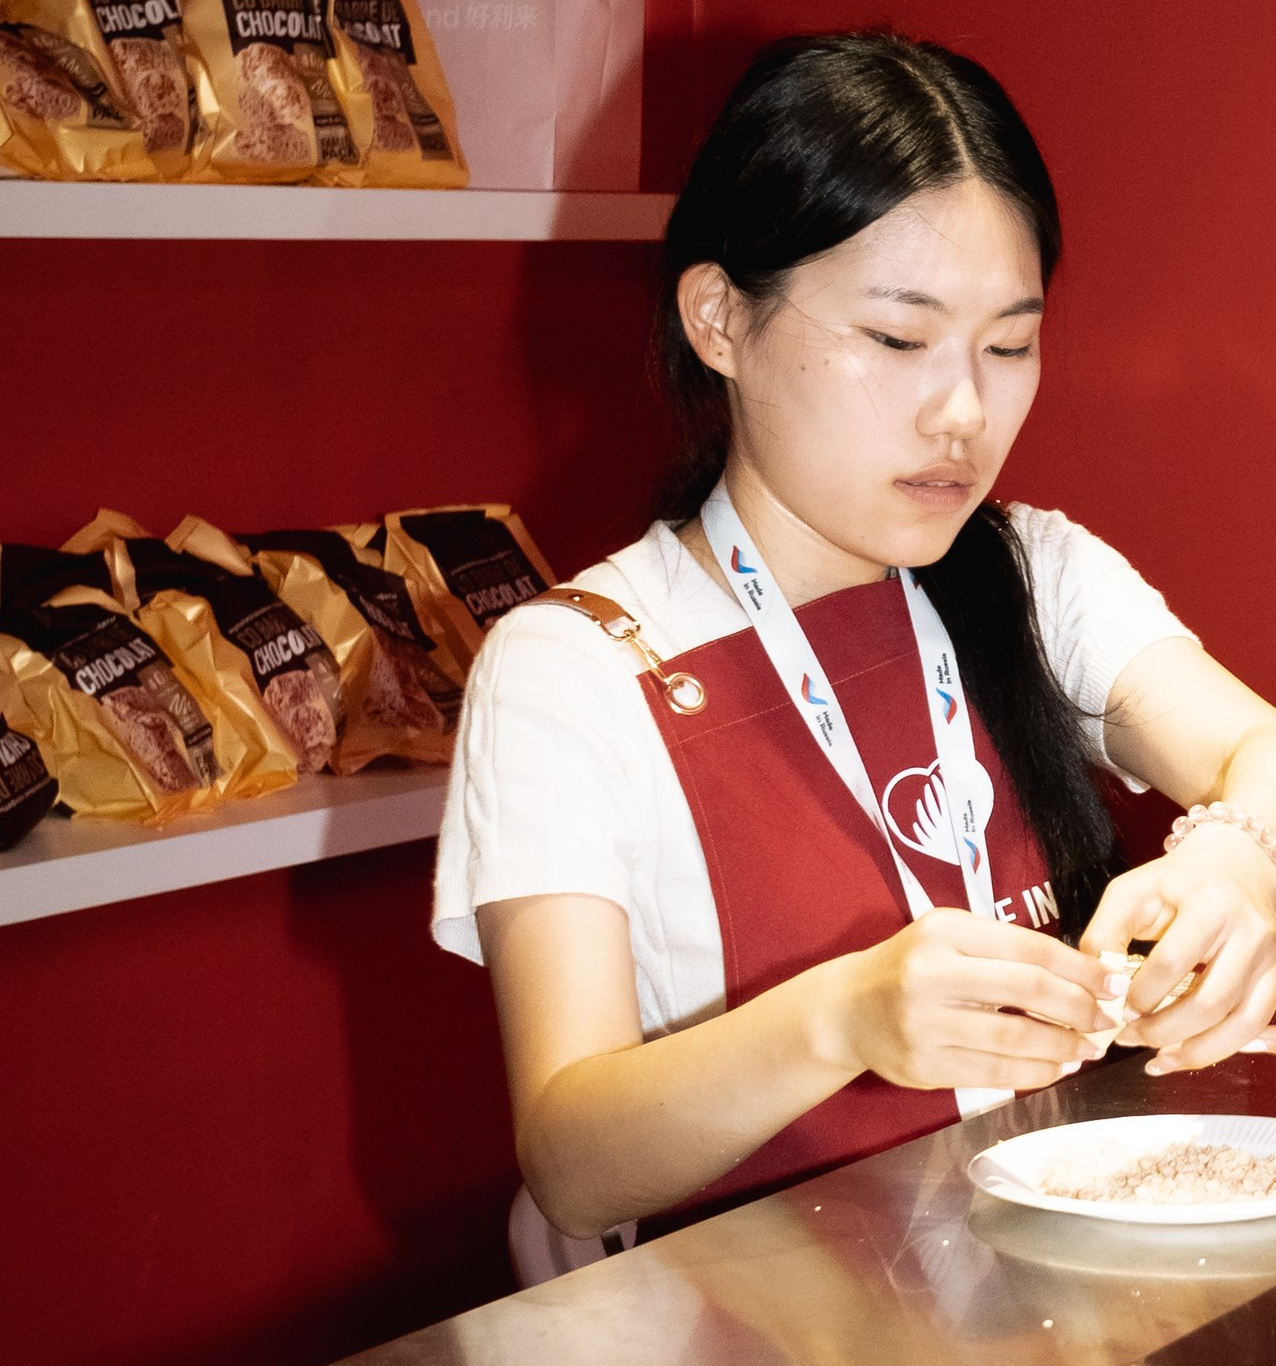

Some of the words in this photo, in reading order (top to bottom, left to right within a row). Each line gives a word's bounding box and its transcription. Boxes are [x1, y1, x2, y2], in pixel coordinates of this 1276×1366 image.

[236, 10, 322, 41] CHOCOLAT
[464, 2, 539, 30] 好利来
[747, 589, 762, 611] Russia
[76, 637, 157, 696] CHOCOLAT
[941, 653, 951, 676] Russia
[819, 722, 833, 747] Russia
[1021, 881, 1060, 929] IN
